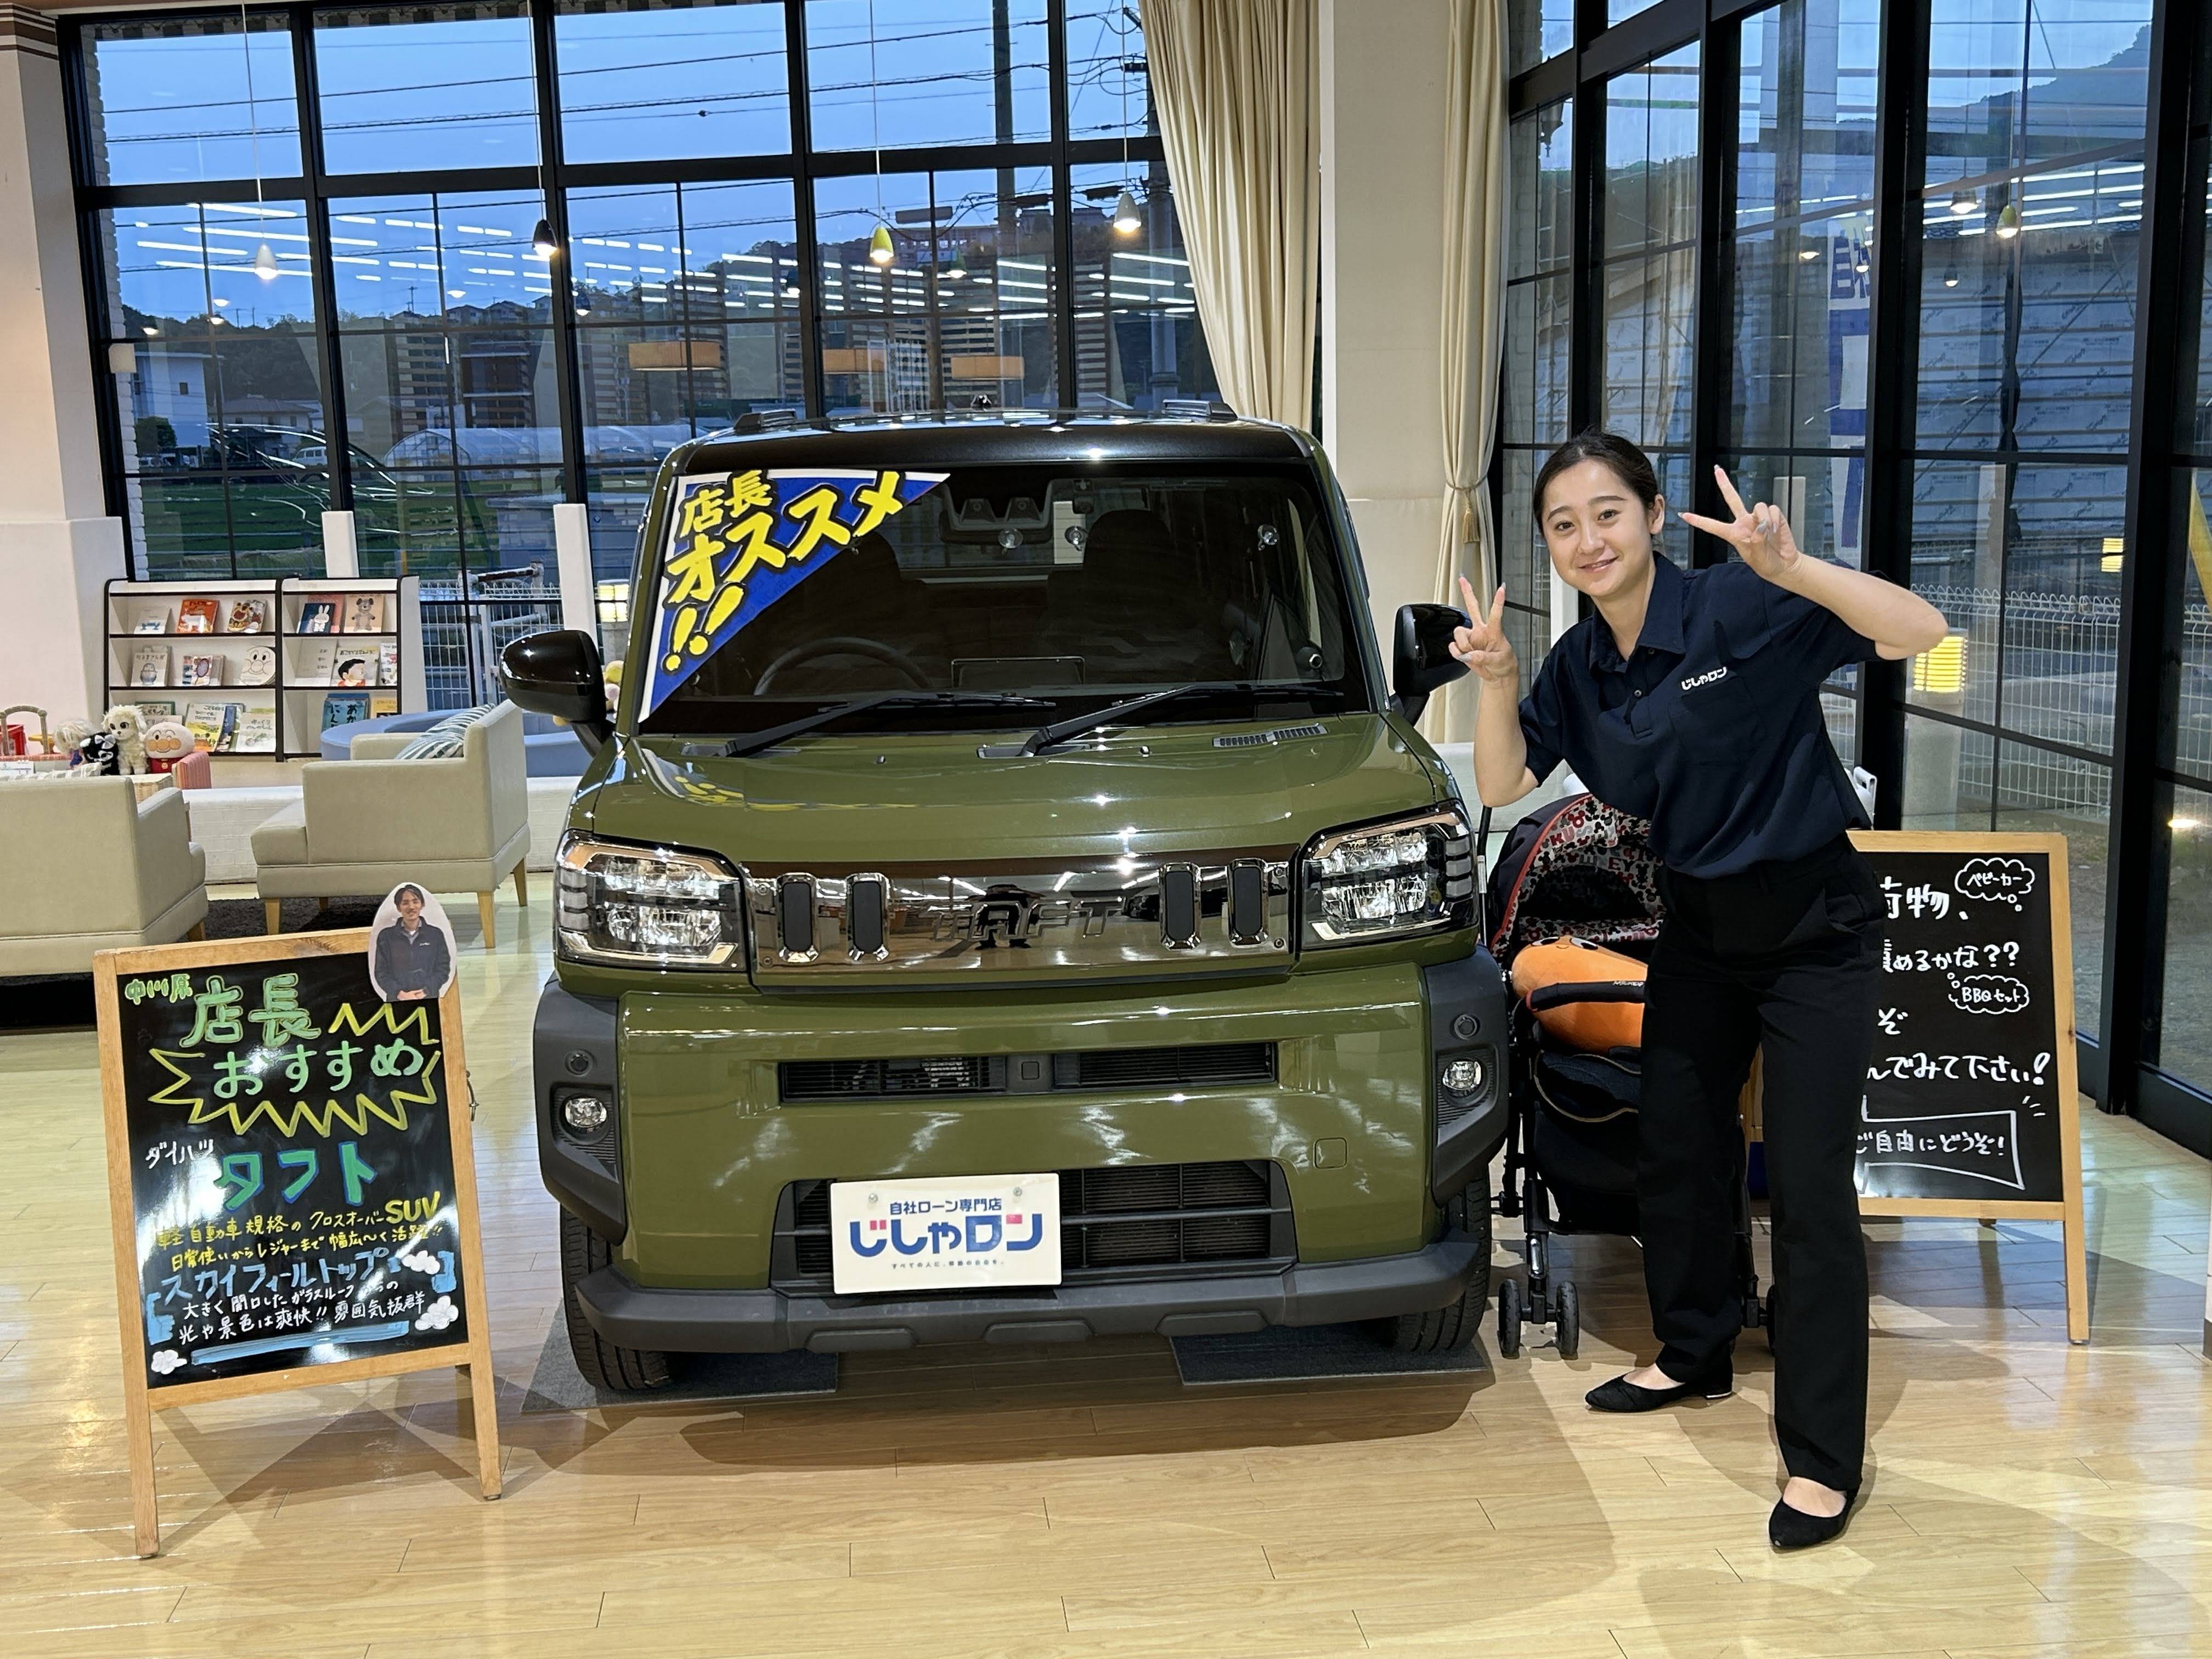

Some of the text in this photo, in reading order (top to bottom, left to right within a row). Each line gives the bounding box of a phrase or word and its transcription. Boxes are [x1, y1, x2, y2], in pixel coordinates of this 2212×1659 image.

[680, 470, 772, 538] 店長
[667, 471, 903, 603] オススメ
[1681, 666, 1728, 690] じしゃロン
[1966, 872, 2023, 887] ベビーカー
[125, 973, 322, 1048] 中川原 店長
[213, 1038, 424, 1098] おすすめ
[145, 1139, 214, 1169] ダイハツ
[213, 1141, 378, 1212] タフト
[849, 1212, 1043, 1258] じしゃロン
[889, 1197, 1003, 1216] 自社ローン専門店
[161, 1246, 390, 1306] スカイフィールトップ
